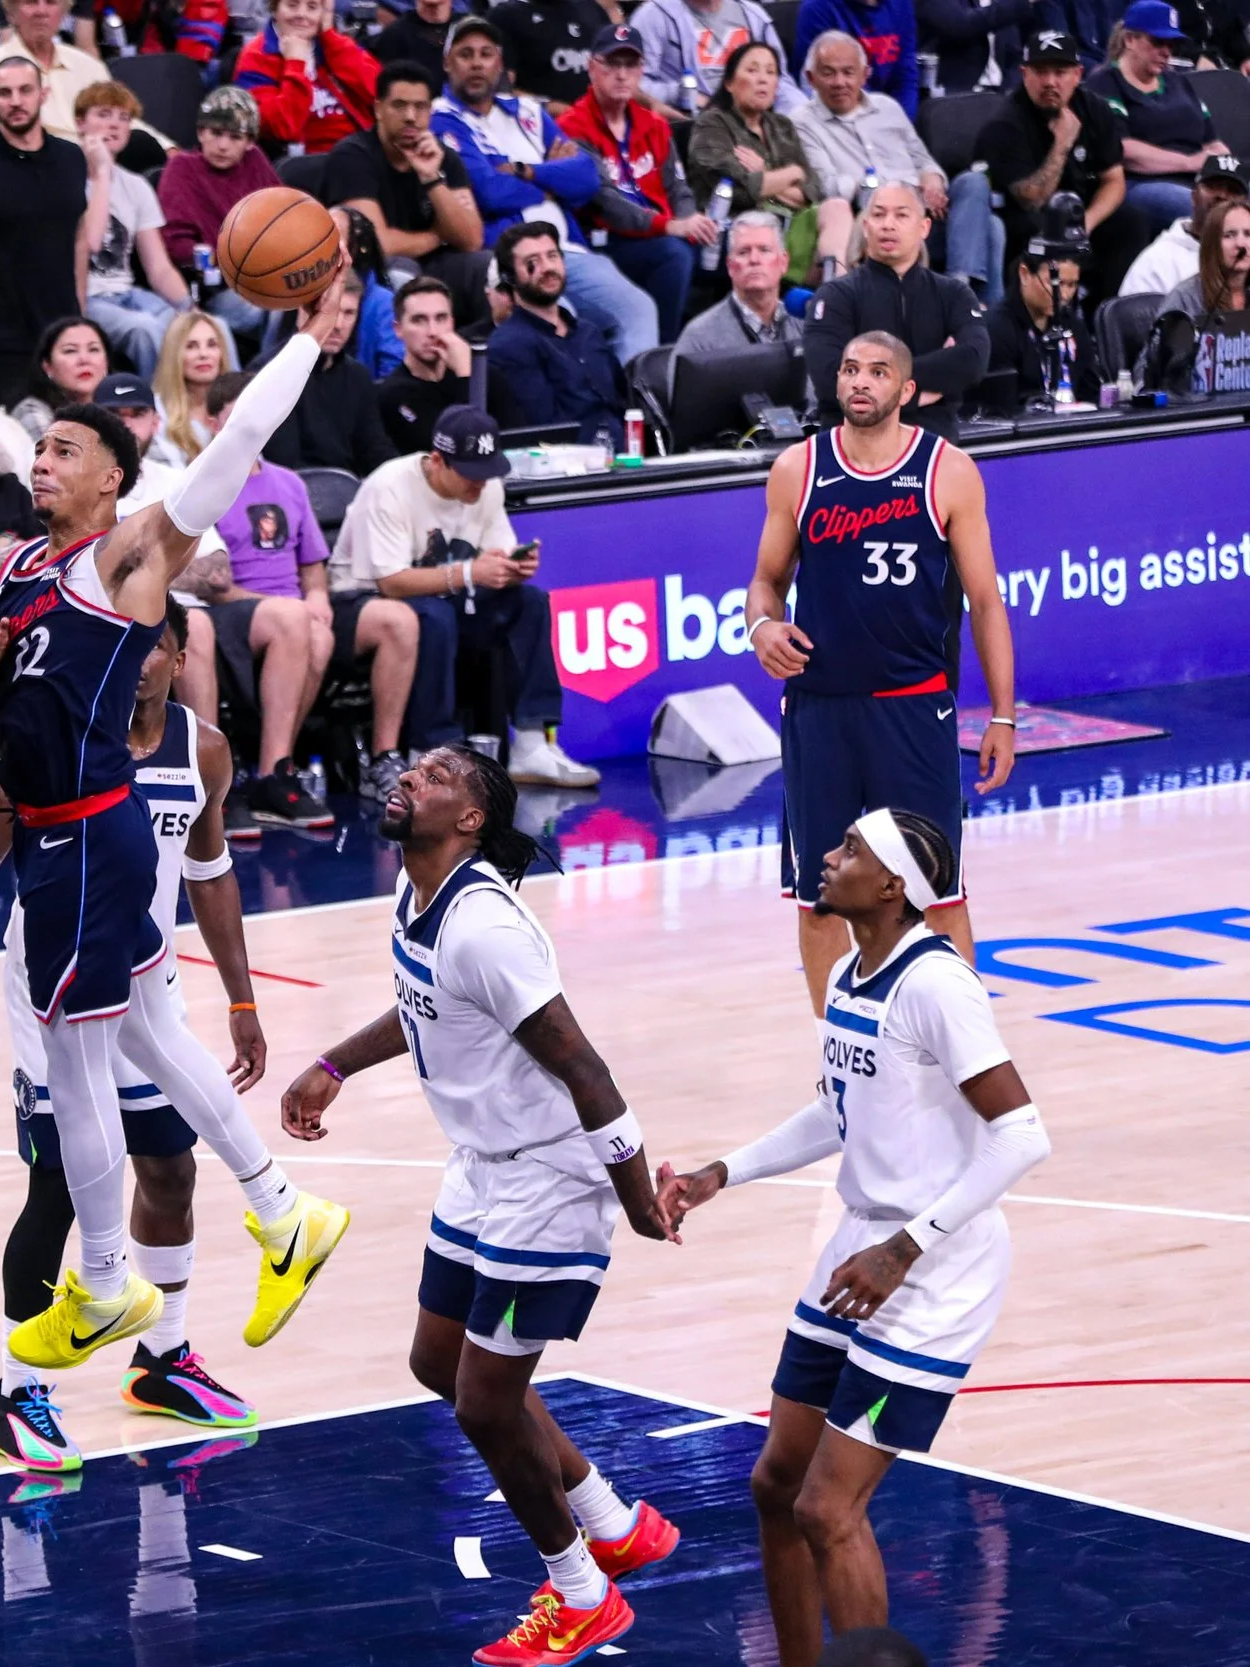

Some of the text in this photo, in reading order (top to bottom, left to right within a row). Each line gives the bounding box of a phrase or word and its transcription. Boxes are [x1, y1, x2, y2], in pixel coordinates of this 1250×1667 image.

[892, 481, 923, 489] RWANDA
[808, 494, 920, 544] Clippers
[862, 541, 918, 586] 33
[1061, 546, 1126, 607] big
[558, 601, 648, 675] us
[609, 1136, 626, 1152] 11
